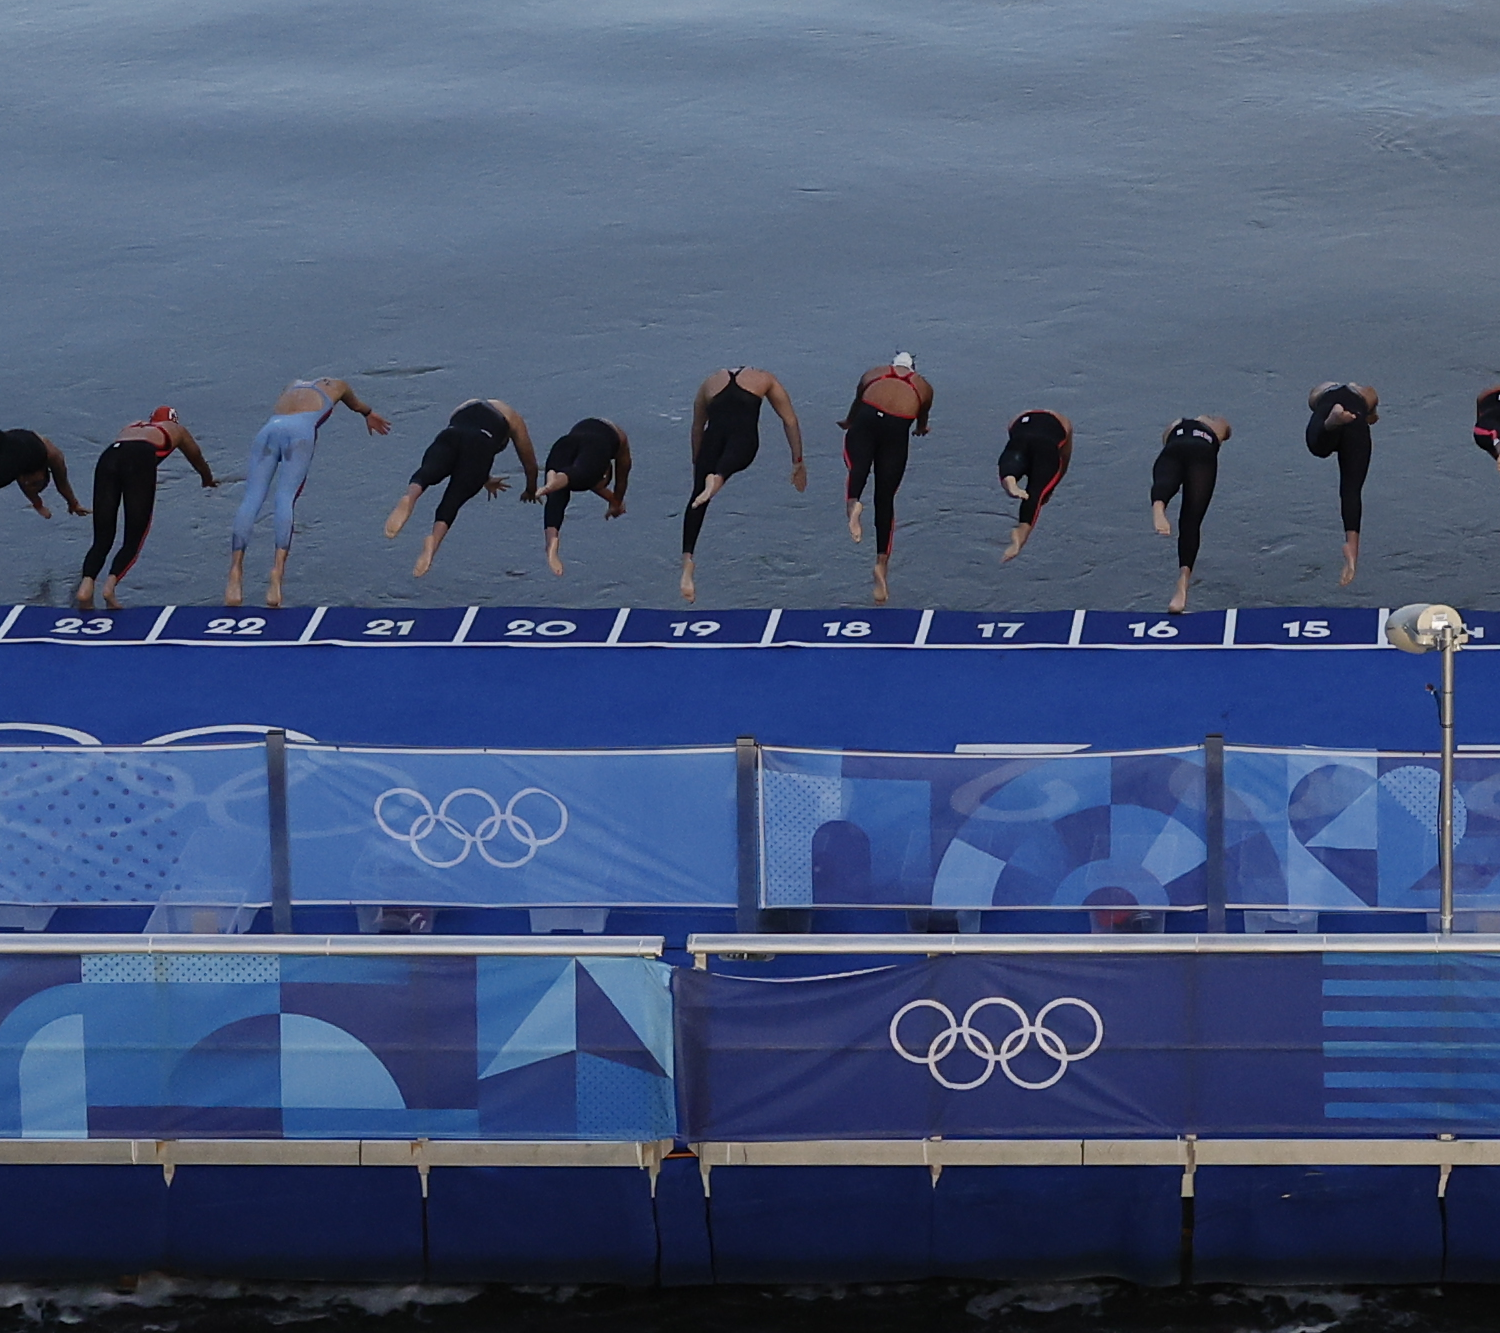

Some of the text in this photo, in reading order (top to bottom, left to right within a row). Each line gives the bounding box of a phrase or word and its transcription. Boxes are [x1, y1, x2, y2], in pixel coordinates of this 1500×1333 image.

[50, 617, 113, 635] 23
[204, 617, 266, 635] 22
[363, 620, 415, 635] 21
[505, 620, 577, 636] 20
[669, 620, 721, 636] 19
[823, 621, 872, 637] 18
[977, 622, 1025, 637] 17
[1128, 621, 1179, 637] 16
[1283, 621, 1331, 637] 15
